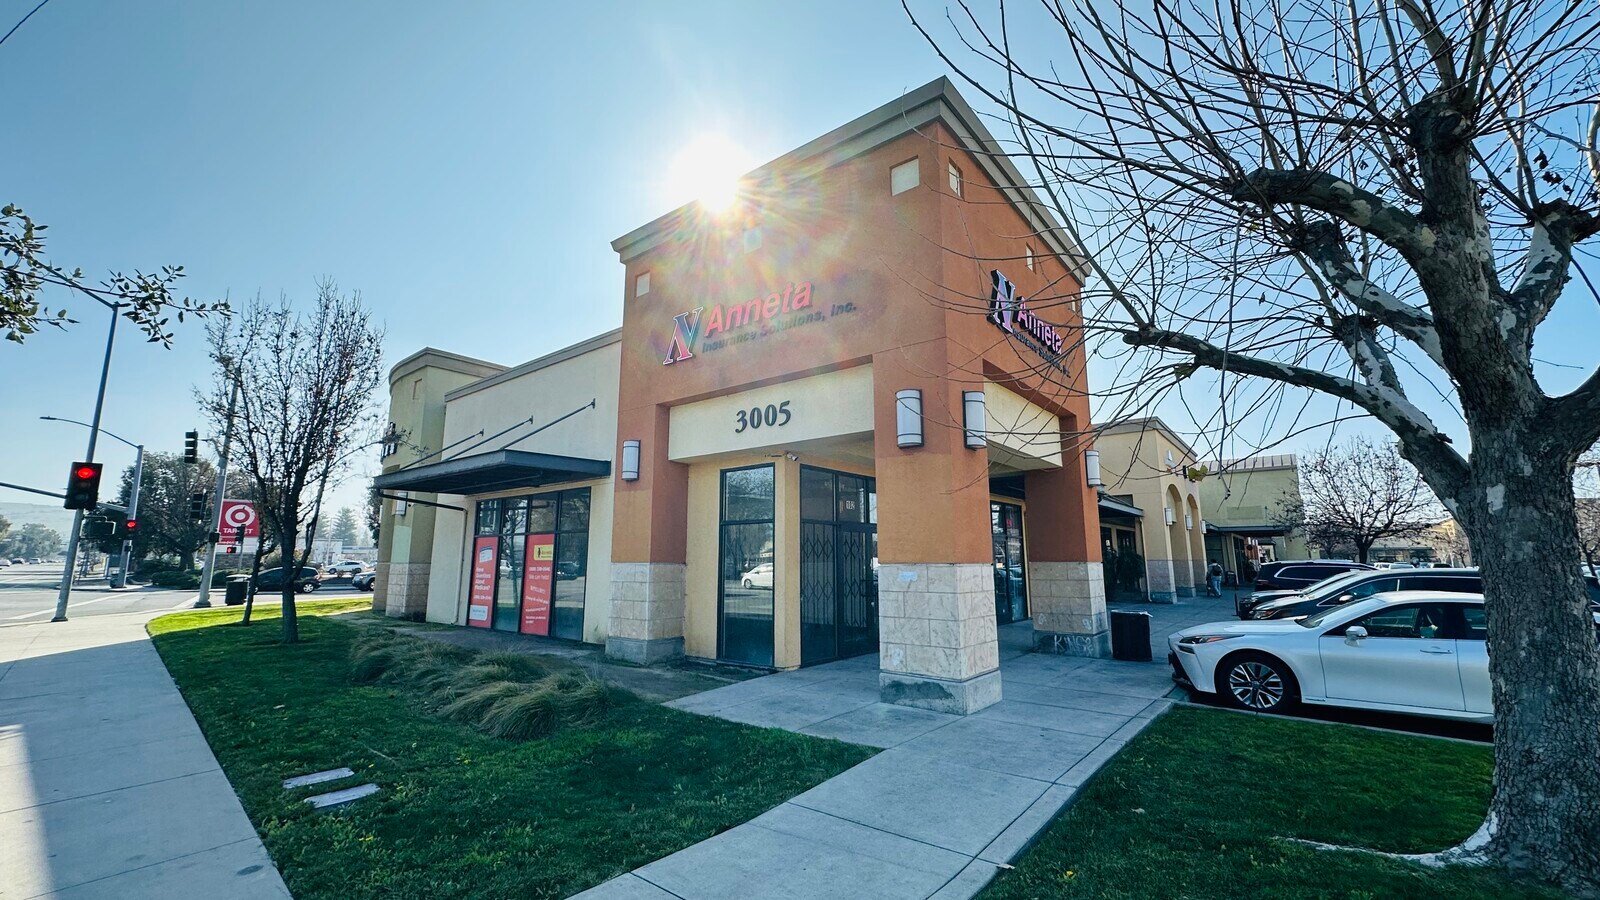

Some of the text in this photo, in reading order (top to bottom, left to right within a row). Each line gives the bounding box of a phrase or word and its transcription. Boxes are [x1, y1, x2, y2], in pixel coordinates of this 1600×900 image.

[702, 331, 757, 354] Insurance
[830, 302, 857, 317] Inc.
[704, 281, 814, 338] Anneta
[735, 400, 792, 433] 3005
